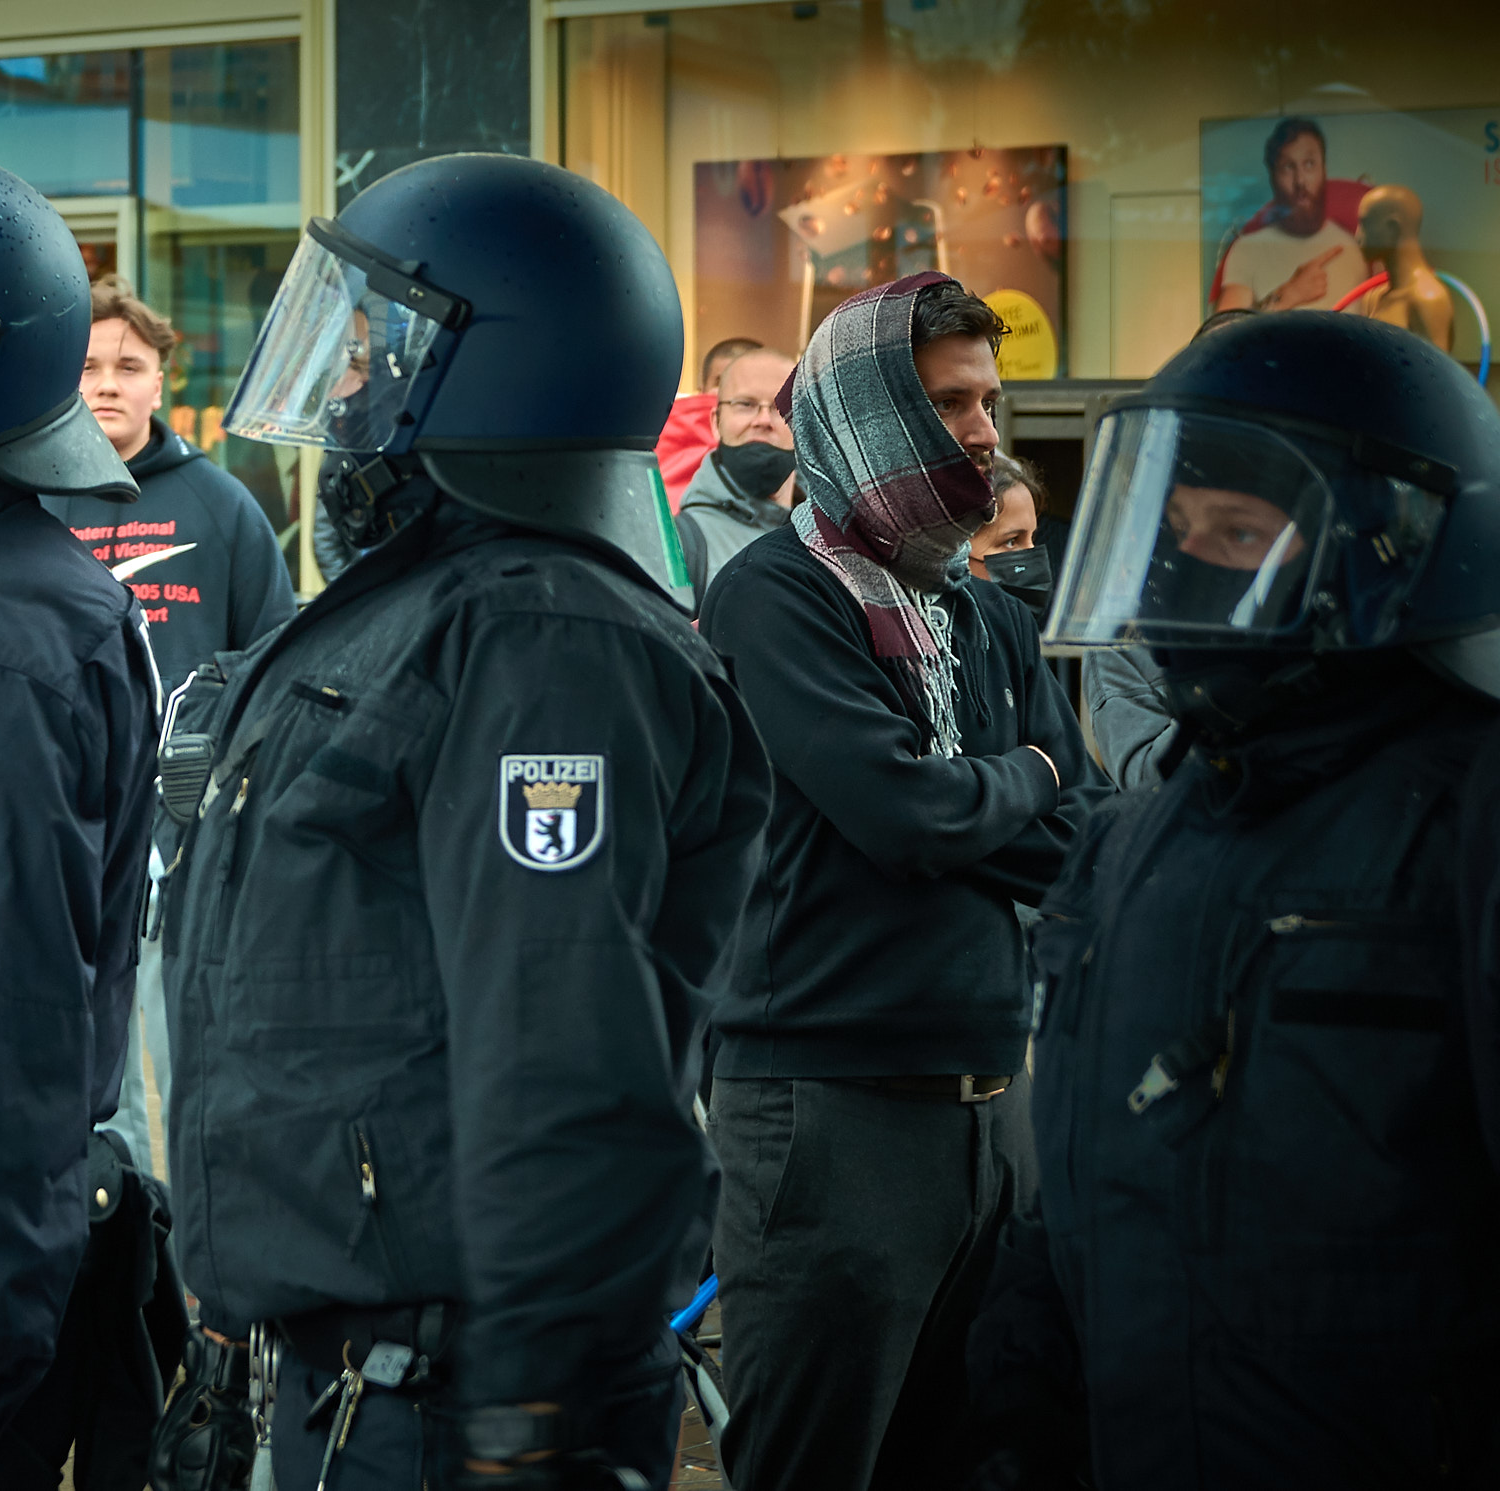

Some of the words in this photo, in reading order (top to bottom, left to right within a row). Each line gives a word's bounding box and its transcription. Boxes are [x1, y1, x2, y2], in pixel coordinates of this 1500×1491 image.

[1009, 321, 1041, 340] OMAT
[92, 545, 111, 561] of
[127, 583, 160, 600] 005
[163, 584, 201, 603] USA
[145, 606, 169, 623] ort
[508, 760, 597, 783] POLIZEI
